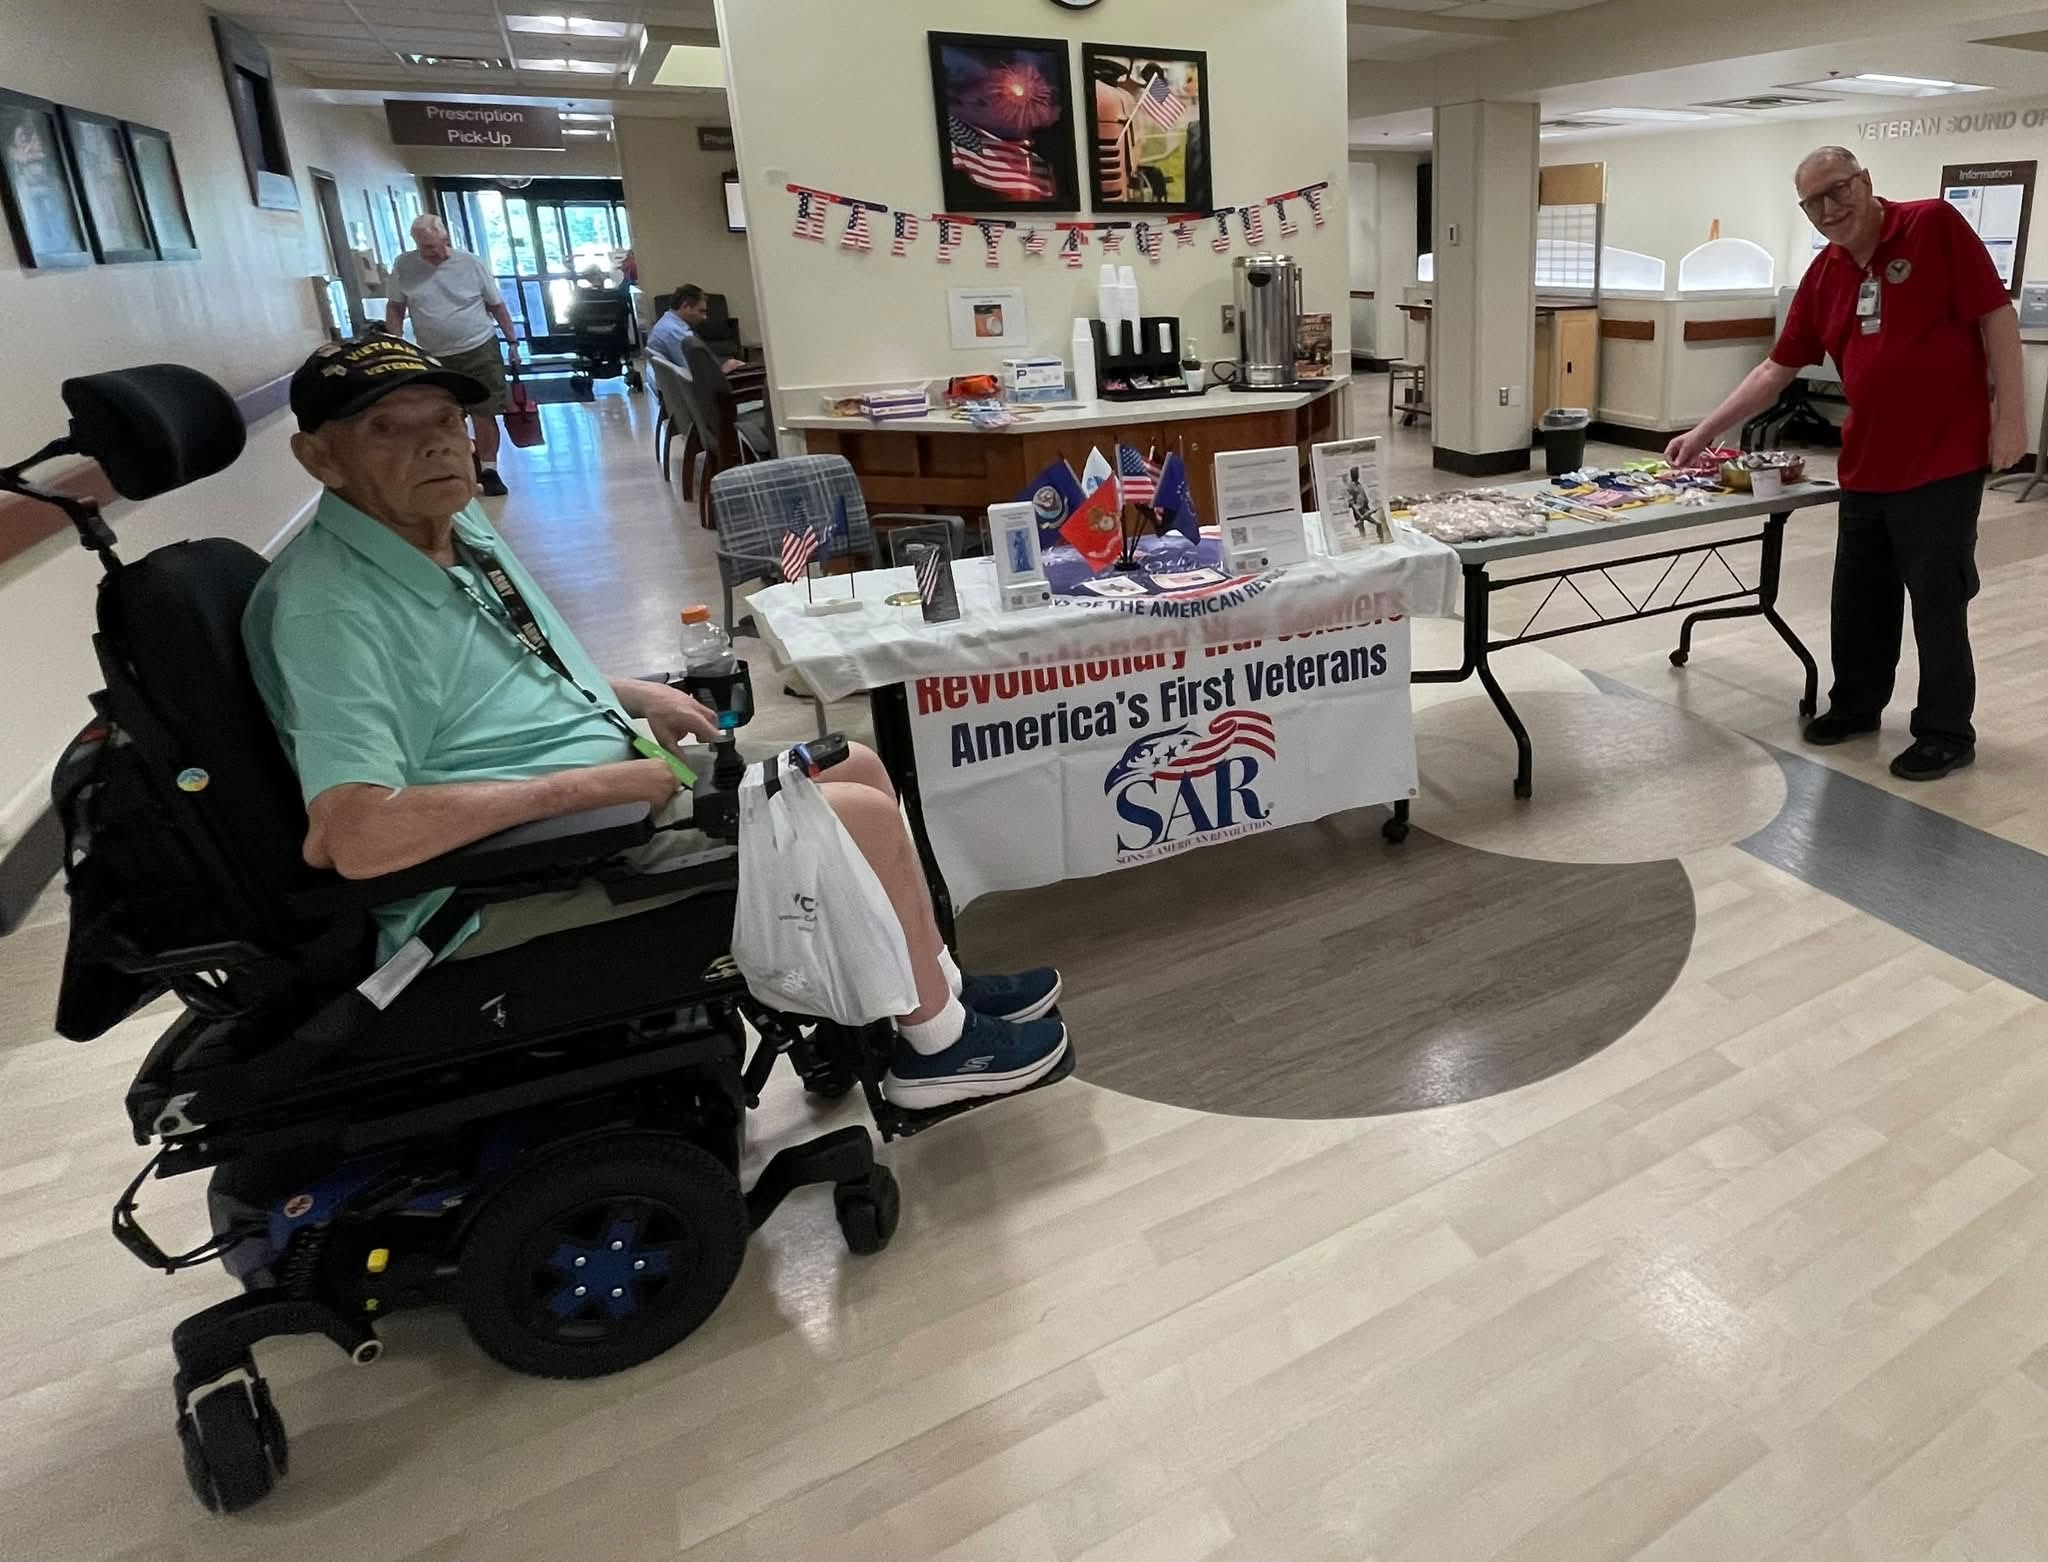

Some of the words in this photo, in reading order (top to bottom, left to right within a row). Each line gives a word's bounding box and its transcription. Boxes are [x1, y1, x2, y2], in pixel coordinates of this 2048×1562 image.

[426, 106, 524, 124] Prescription
[1857, 115, 1942, 141] VETERAN
[1945, 111, 2017, 135] SOUND
[447, 129, 512, 146] Pick-Up
[1959, 169, 2013, 181] Information
[792, 191, 1006, 268] HAPPY
[1212, 188, 1326, 253] JULY
[487, 569, 516, 597] ARMY
[1107, 599, 1145, 615] THE
[1150, 589, 1246, 618] AMERICAN
[914, 634, 1188, 716] Revolutionary
[951, 690, 1150, 768] America's
[1160, 668, 1236, 722] First
[1245, 643, 1387, 701] Veterans
[1115, 756, 1271, 855] SAR
[1210, 819, 1274, 842] REVOLUTION
